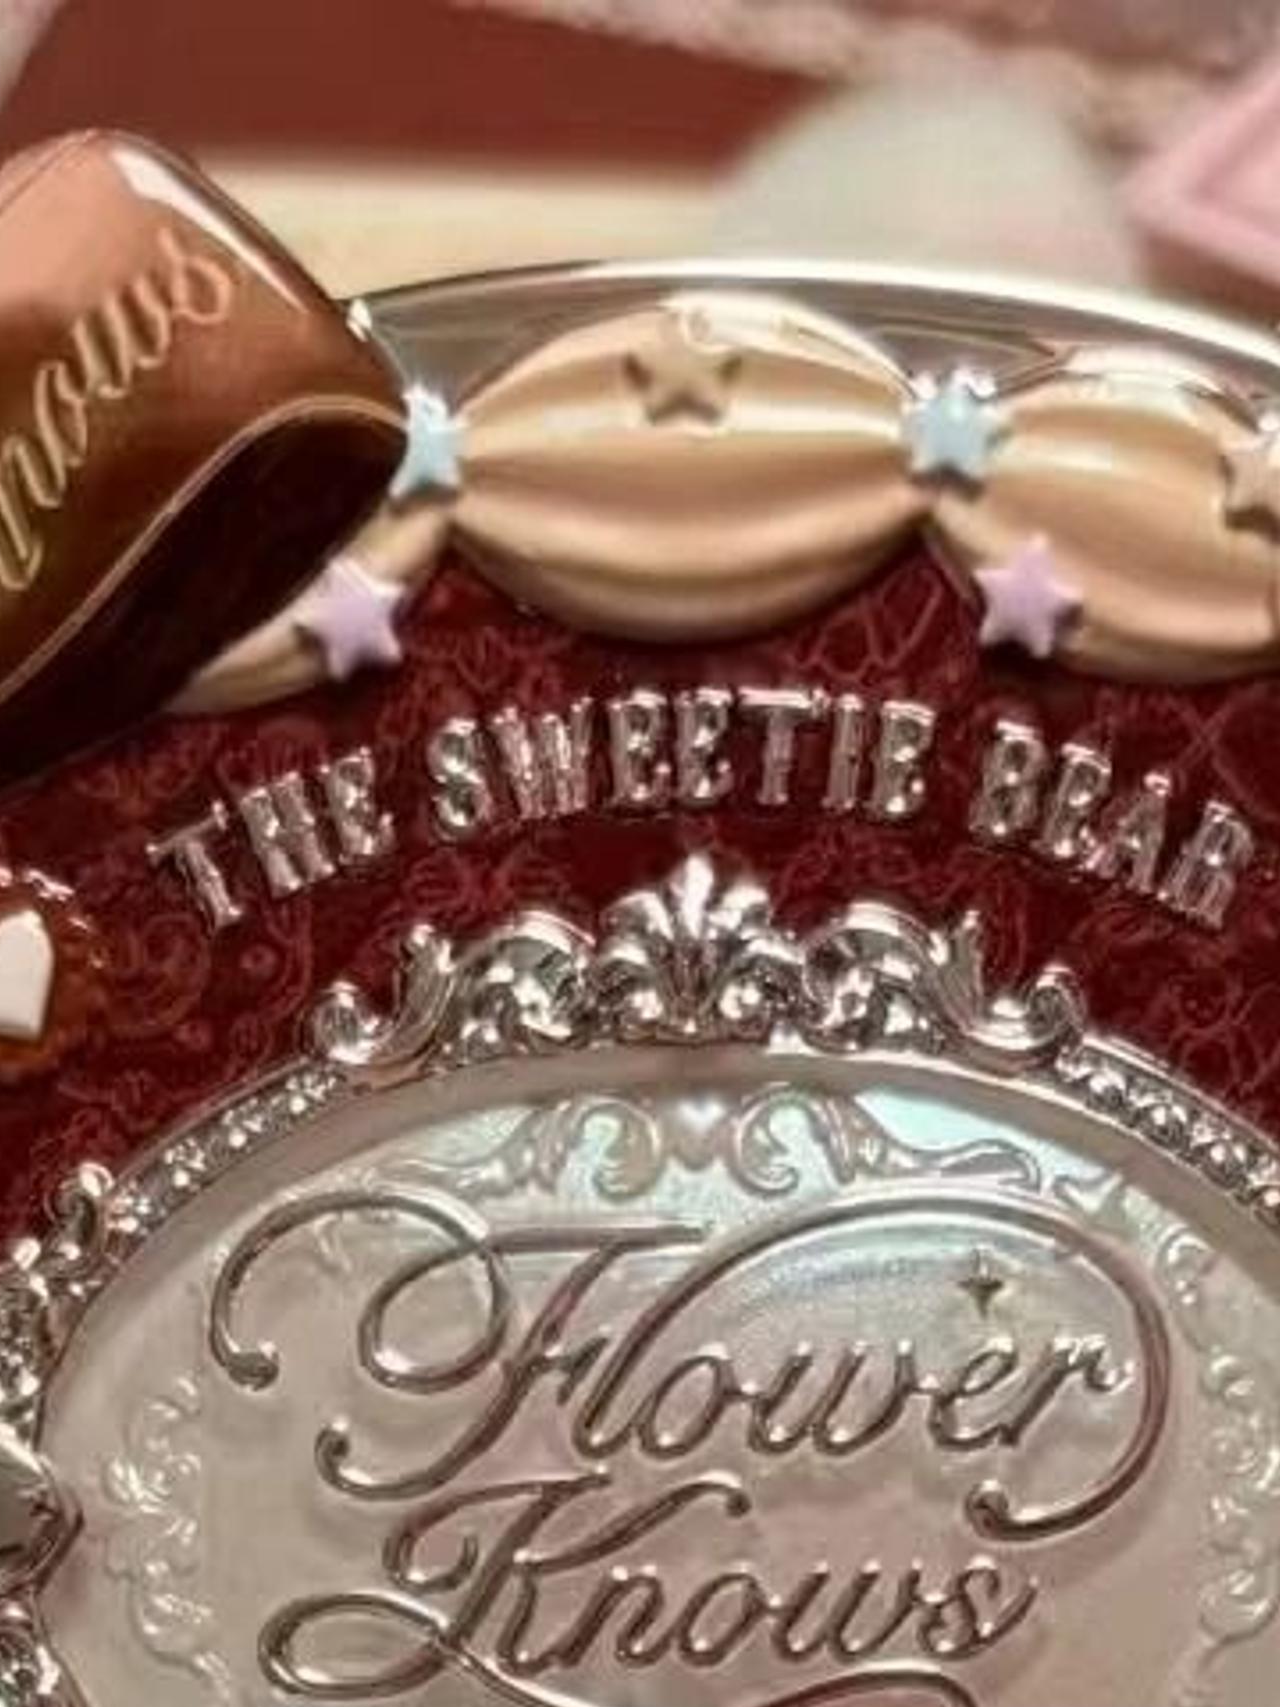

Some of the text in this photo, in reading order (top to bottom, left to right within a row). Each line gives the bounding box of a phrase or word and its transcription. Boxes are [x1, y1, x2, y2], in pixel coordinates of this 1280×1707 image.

[146, 686, 1256, 932] THE SWEETIE BEAR
[208, 1187, 1168, 1541] Flower
